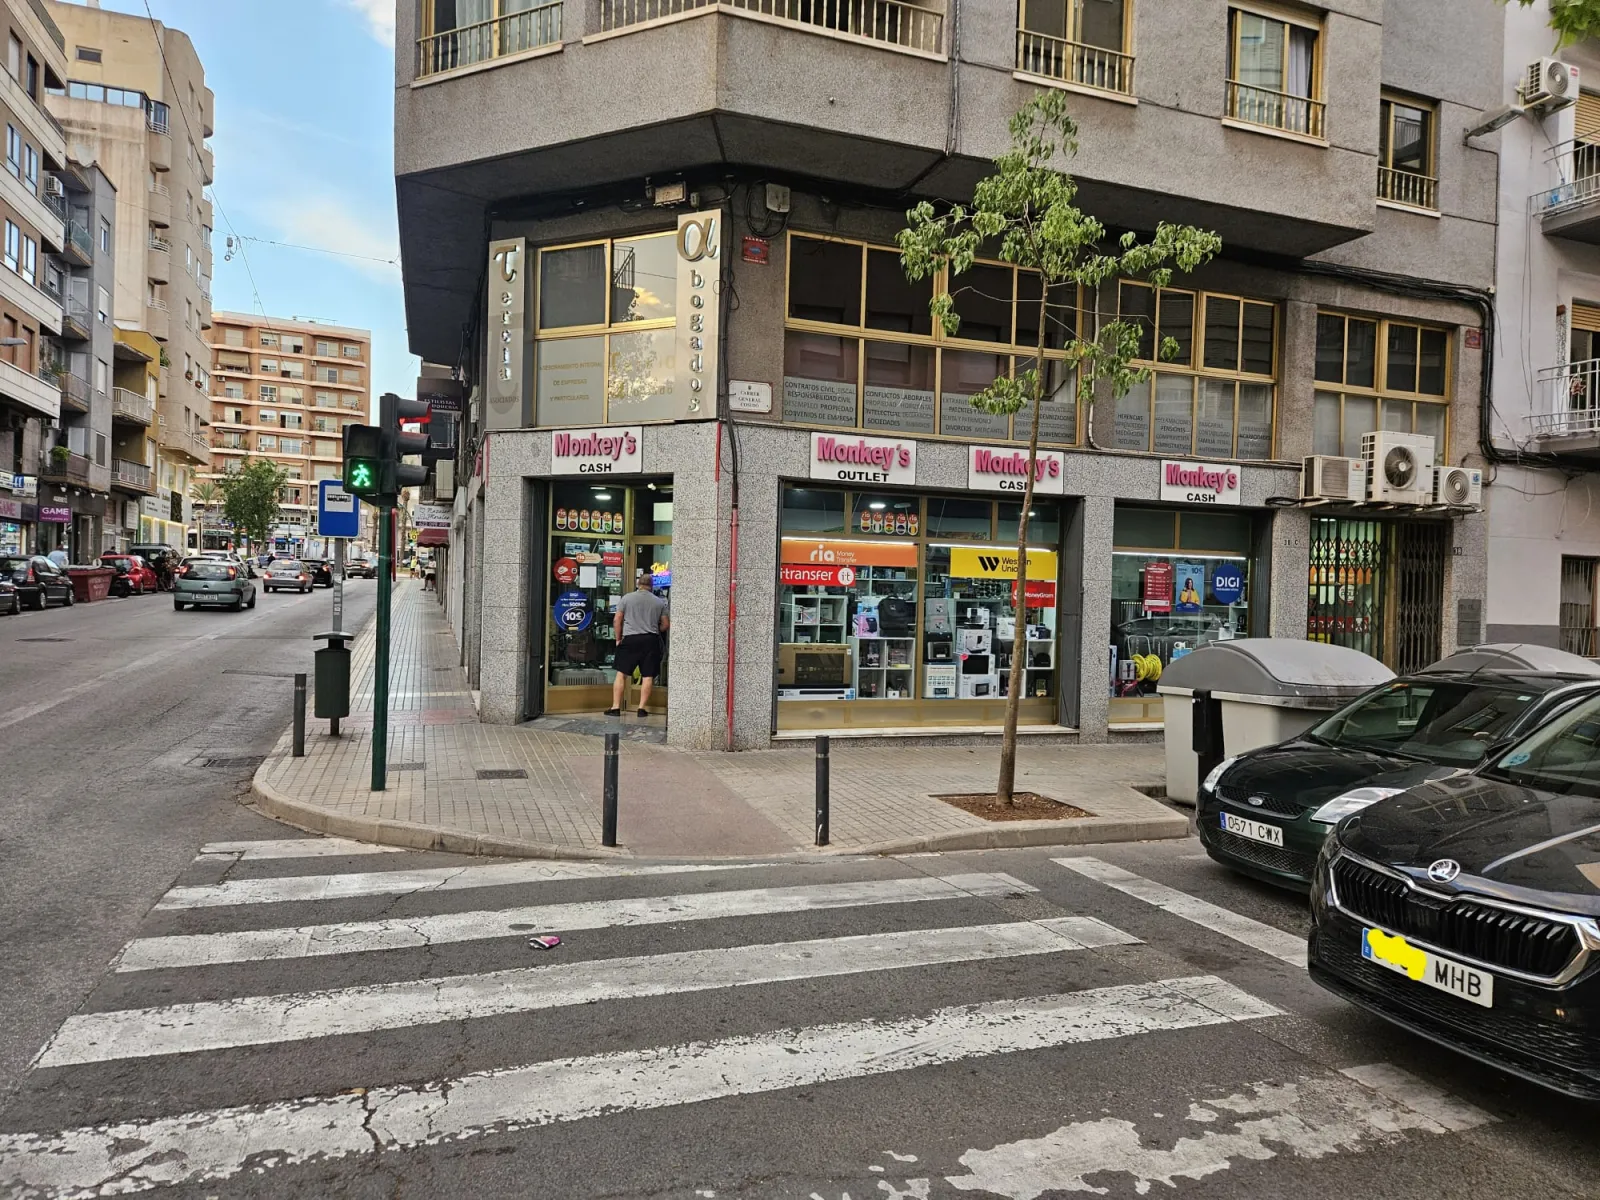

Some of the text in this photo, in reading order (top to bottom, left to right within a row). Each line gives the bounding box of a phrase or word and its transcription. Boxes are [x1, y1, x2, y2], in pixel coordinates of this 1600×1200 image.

[785, 381, 819, 391] CONTRATOS
[788, 391, 837, 401] RESPONSABILIDAD
[866, 391, 900, 399] CONFLICTOS
[820, 404, 854, 412] PROPIEDAD
[785, 410, 817, 419] CONVENIOS
[867, 418, 900, 426] SOCIEDADES
[554, 432, 636, 460] Monkey's
[817, 436, 911, 470] Monkey's
[579, 463, 612, 473] CASH
[838, 470, 889, 482] OUTLET
[1166, 464, 1237, 493] Monkey's
[1187, 493, 1216, 502] CASH
[42, 507, 69, 516] GAME
[810, 544, 835, 562] ria
[1002, 557, 1032, 566] Wesn
[841, 572, 850, 581] it
[1216, 576, 1239, 588] DIGI
[565, 612, 582, 620] 10€
[1228, 816, 1280, 844] 0571 CWX
[1435, 960, 1481, 997] MHB
